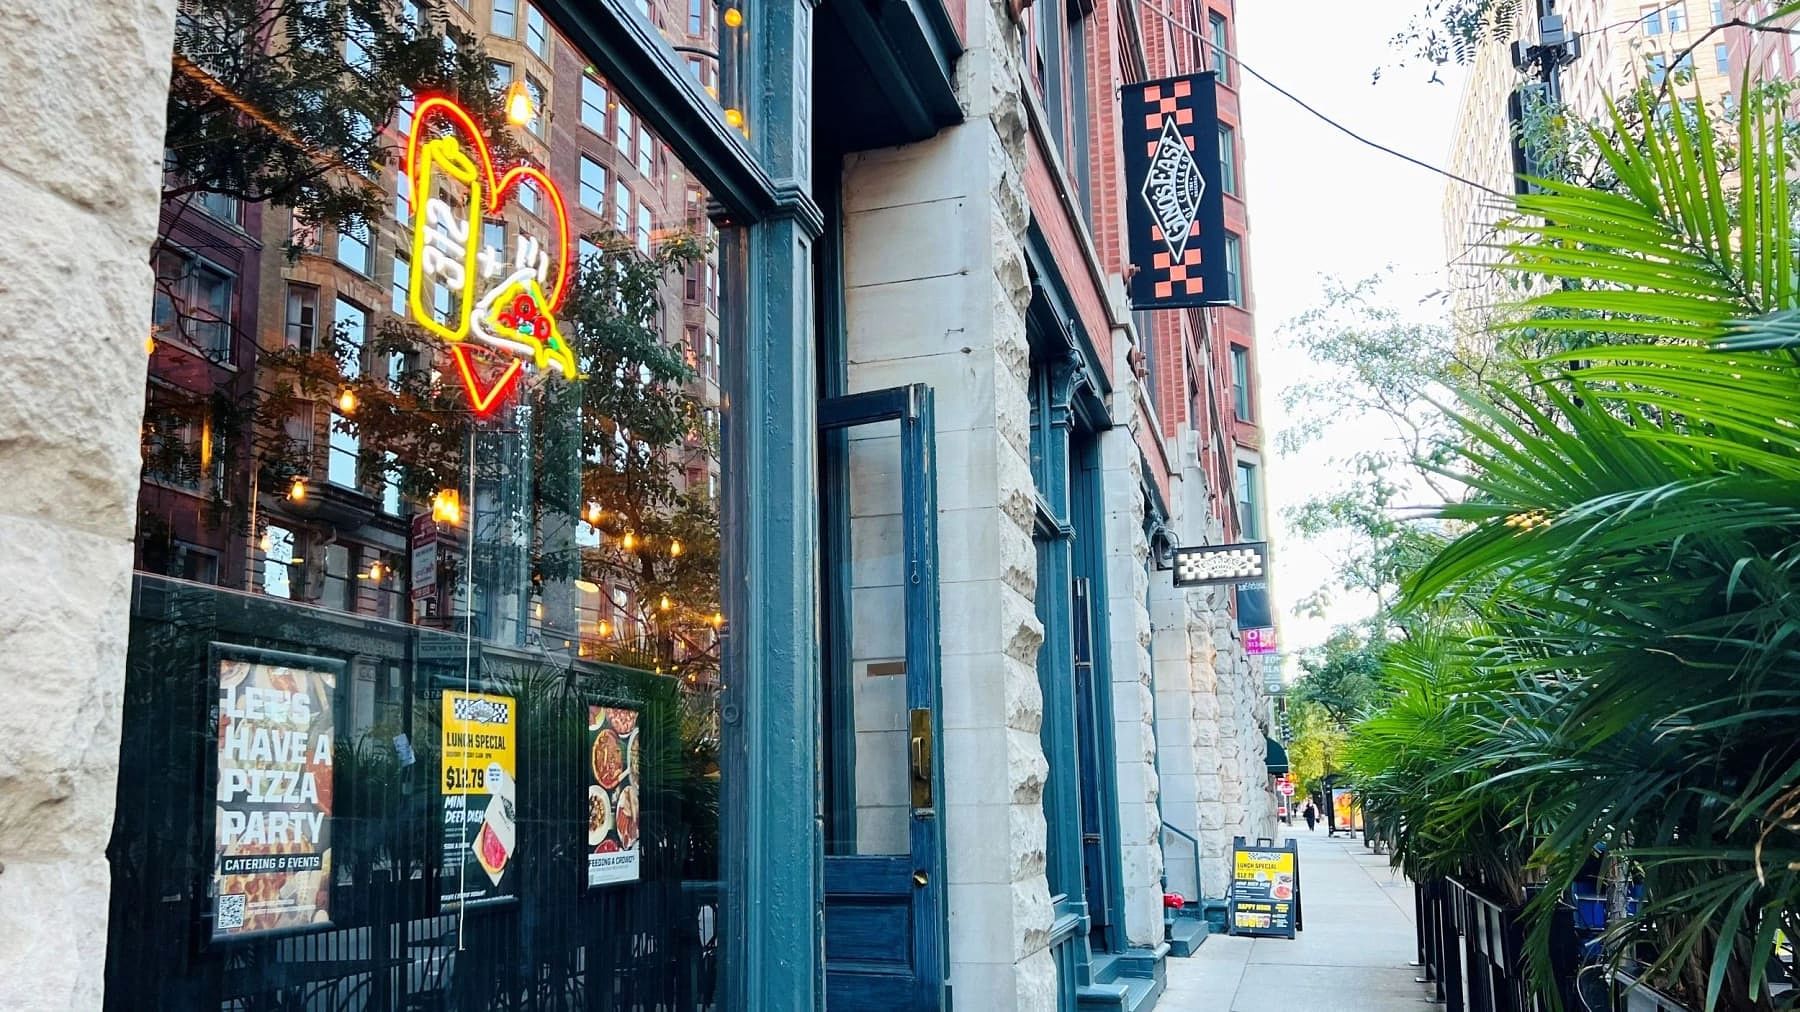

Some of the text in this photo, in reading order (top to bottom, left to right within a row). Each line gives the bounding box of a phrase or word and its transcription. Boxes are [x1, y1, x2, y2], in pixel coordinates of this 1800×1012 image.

[1150, 135, 1189, 242] GINO'S EAST
[1176, 155, 1193, 219] OF CHICAGO
[423, 199, 470, 290] 312
[225, 685, 311, 725] LET'S
[224, 726, 332, 766] HAVE A
[475, 734, 506, 750] SPECIAL
[223, 768, 319, 804] PIZZA
[446, 765, 484, 791] $12.79
[221, 811, 324, 845] PARTY
[466, 810, 485, 824] DISH
[225, 856, 320, 871] CATERING & EVENTS
